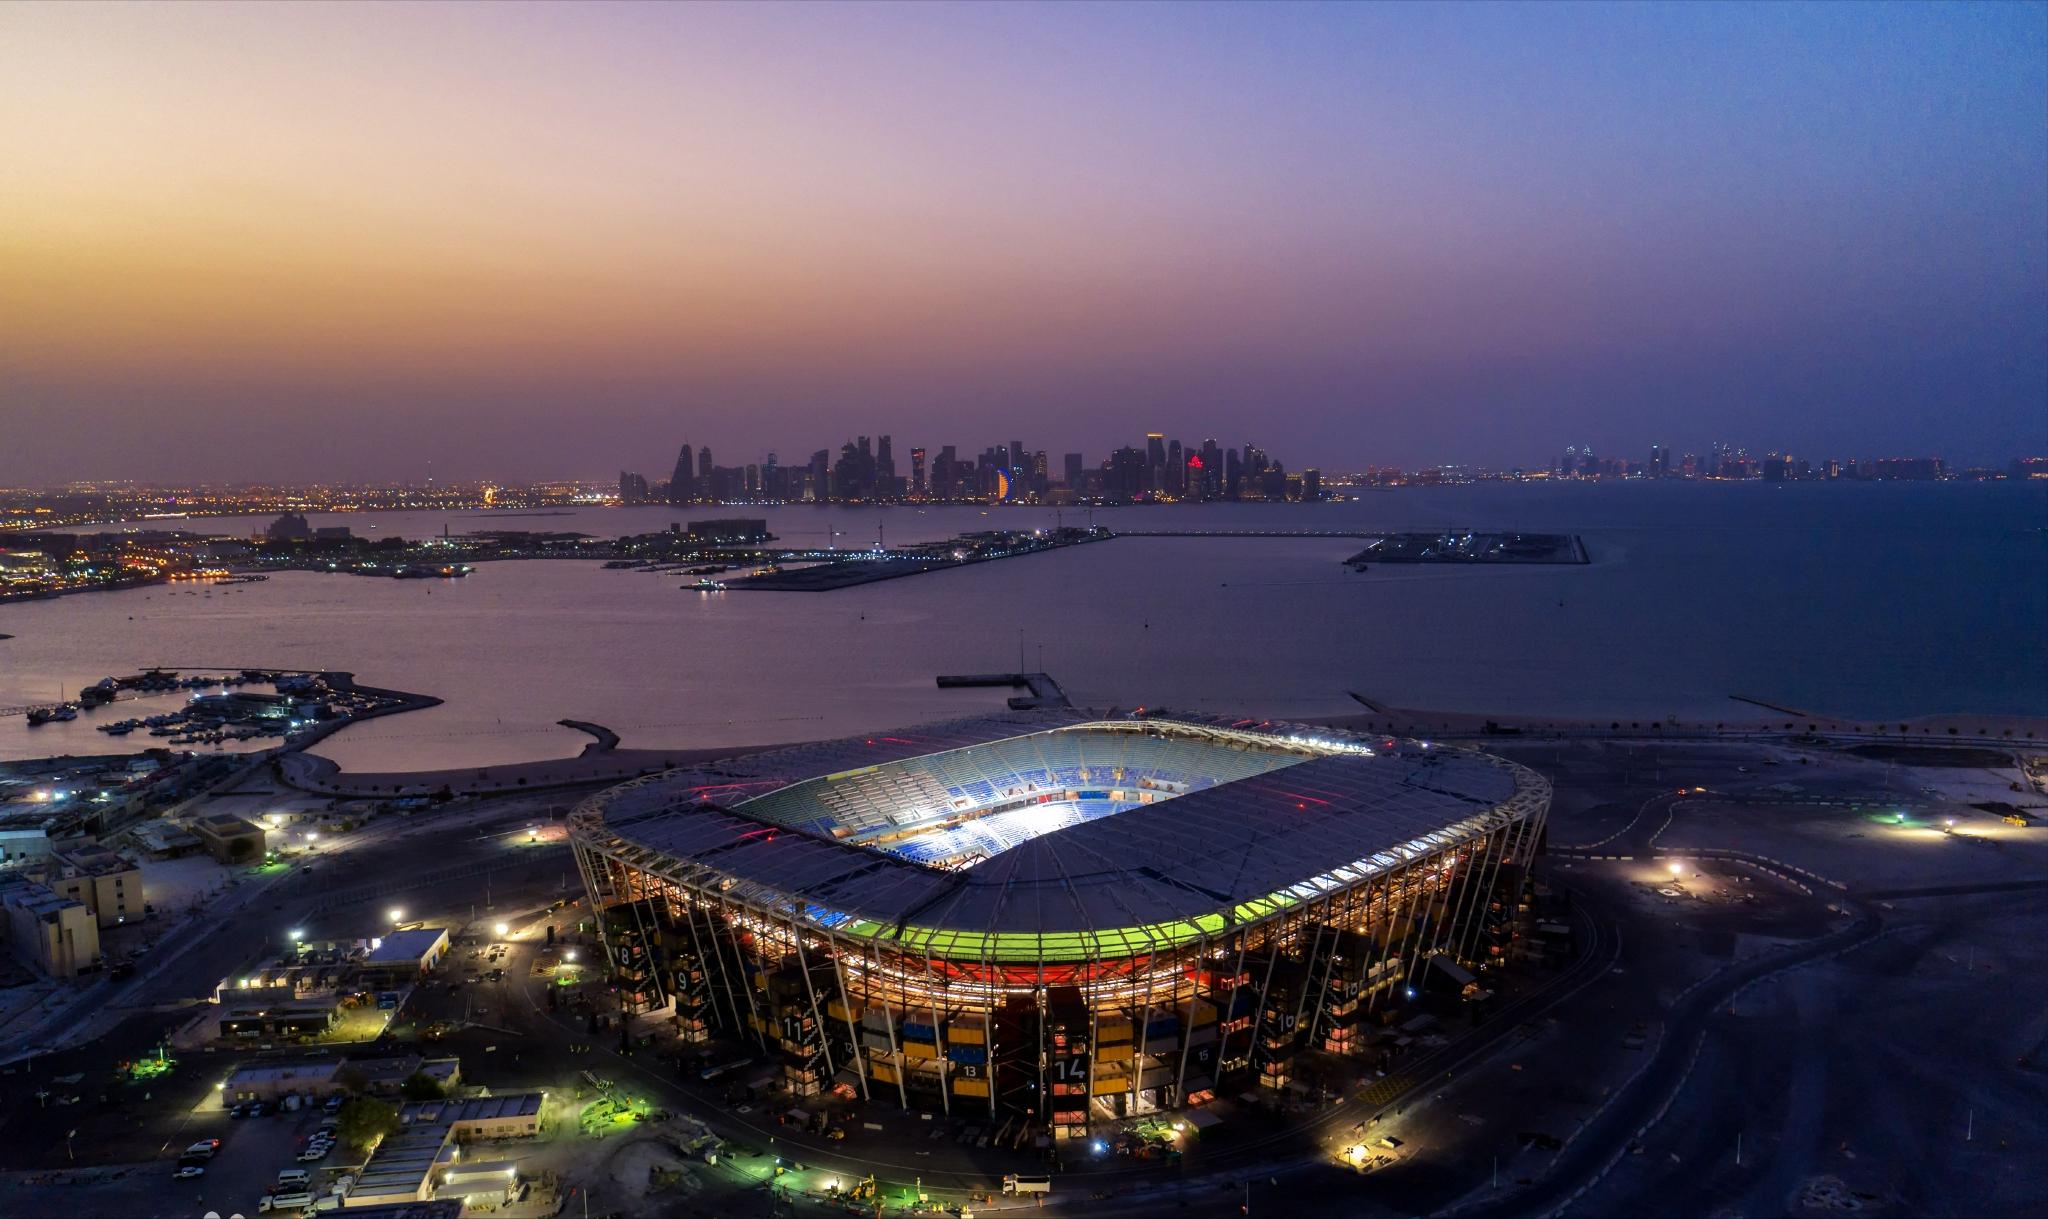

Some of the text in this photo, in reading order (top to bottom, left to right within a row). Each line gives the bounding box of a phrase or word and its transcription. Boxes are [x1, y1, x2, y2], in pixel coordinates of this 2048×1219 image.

[621, 947, 629, 965] 8
[678, 972, 687, 990] 9
[784, 1017, 801, 1041] 11
[1279, 1012, 1295, 1032] 16
[1198, 1048, 1209, 1061] 15
[963, 1066, 976, 1077] 13
[1054, 1058, 1086, 1079] 14
